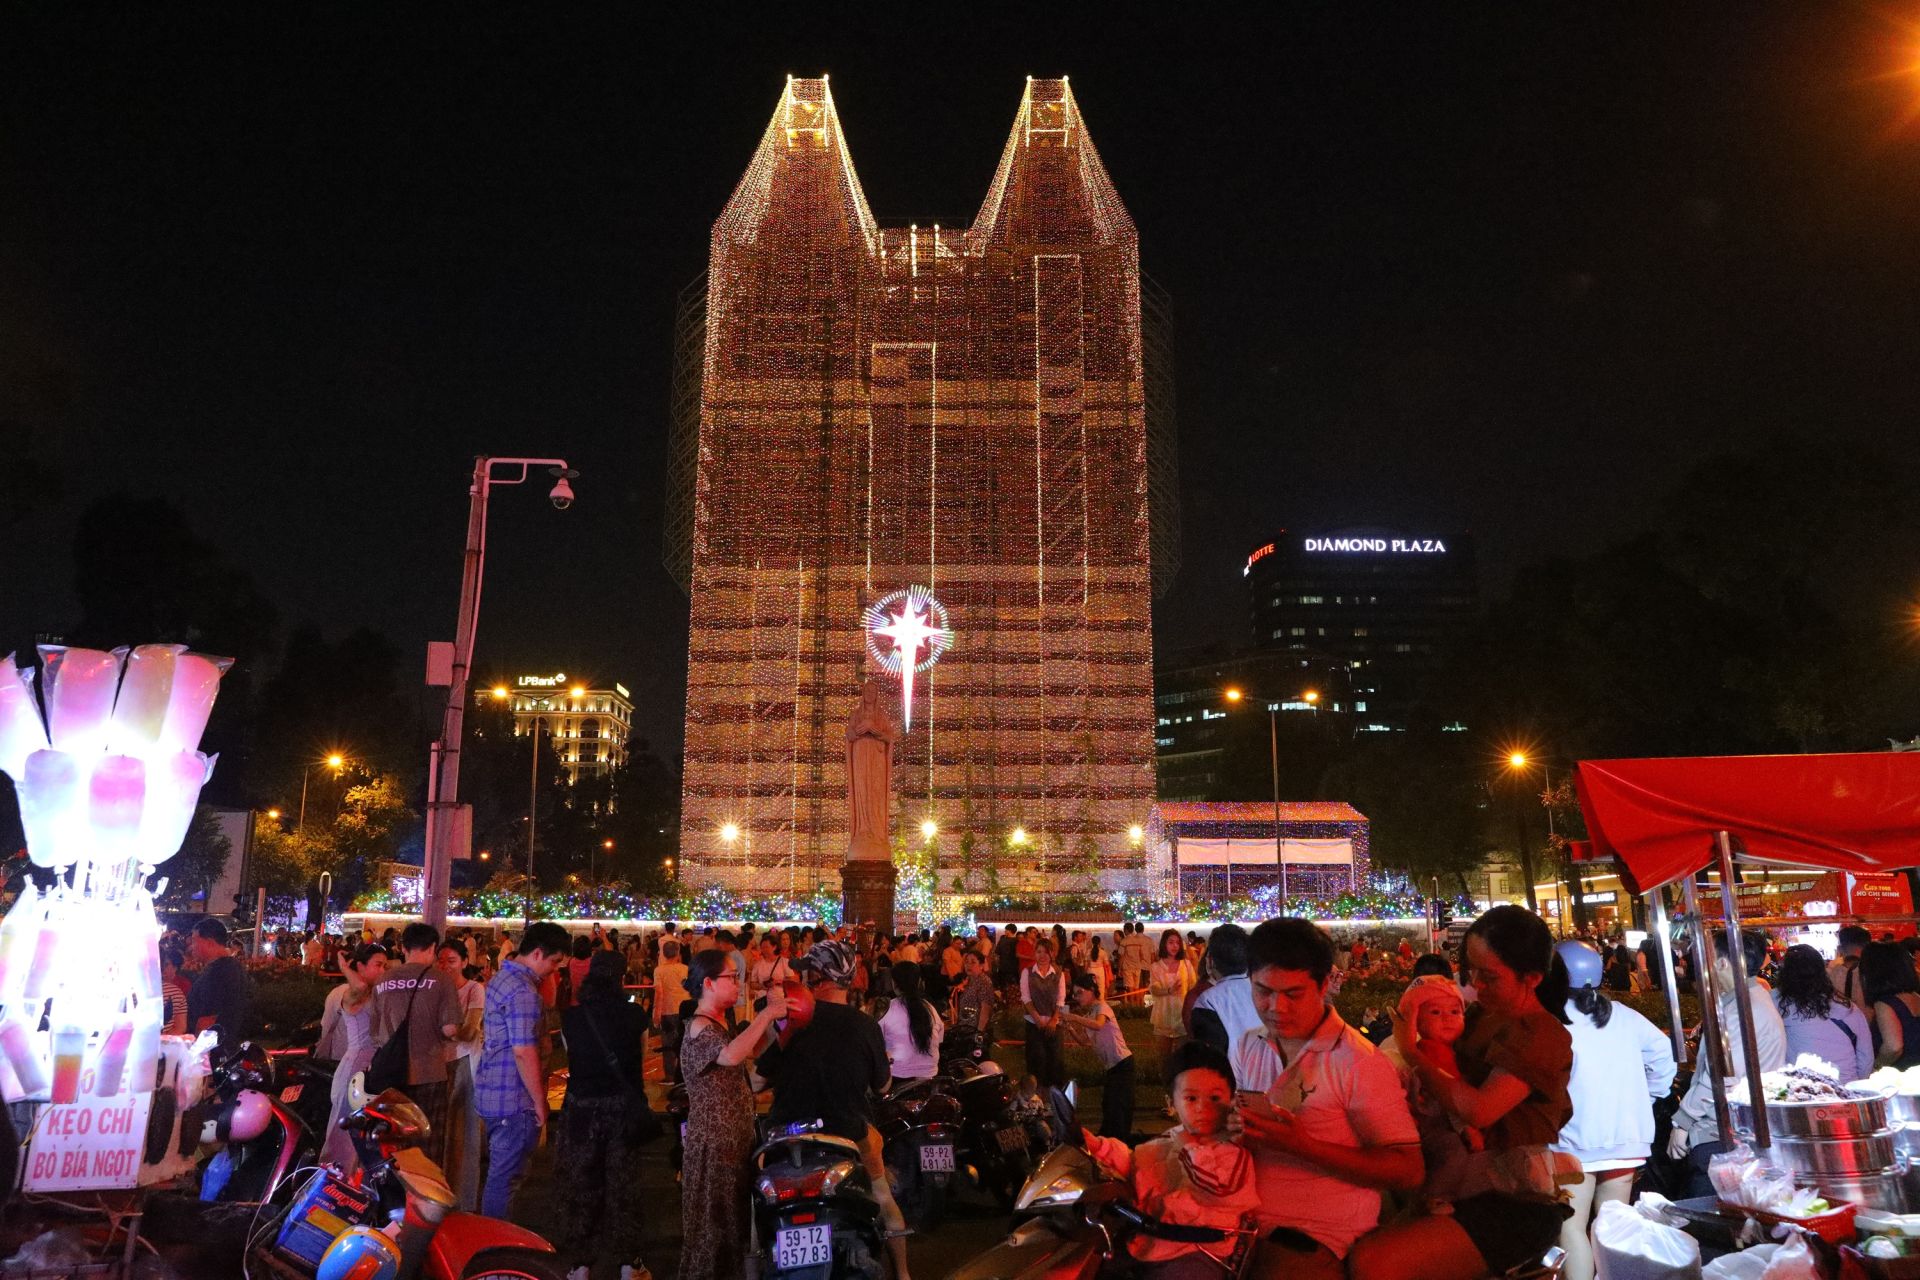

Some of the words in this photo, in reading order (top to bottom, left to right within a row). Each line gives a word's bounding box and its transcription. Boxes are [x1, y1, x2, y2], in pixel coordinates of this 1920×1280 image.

[1252, 543, 1275, 562] LOTTE
[1305, 538, 1387, 552] DIAMOND
[1391, 540, 1446, 553] PLAZA
[518, 676, 556, 686] LPBank
[47, 1107, 93, 1141] KẸO
[97, 1097, 136, 1134] CHỈ
[32, 1144, 58, 1180] BÒ
[61, 1143, 89, 1179] BÍA
[92, 1149, 136, 1182] NGỌT
[785, 1227, 823, 1247] 59-T2
[781, 1245, 829, 1267] 357.83
